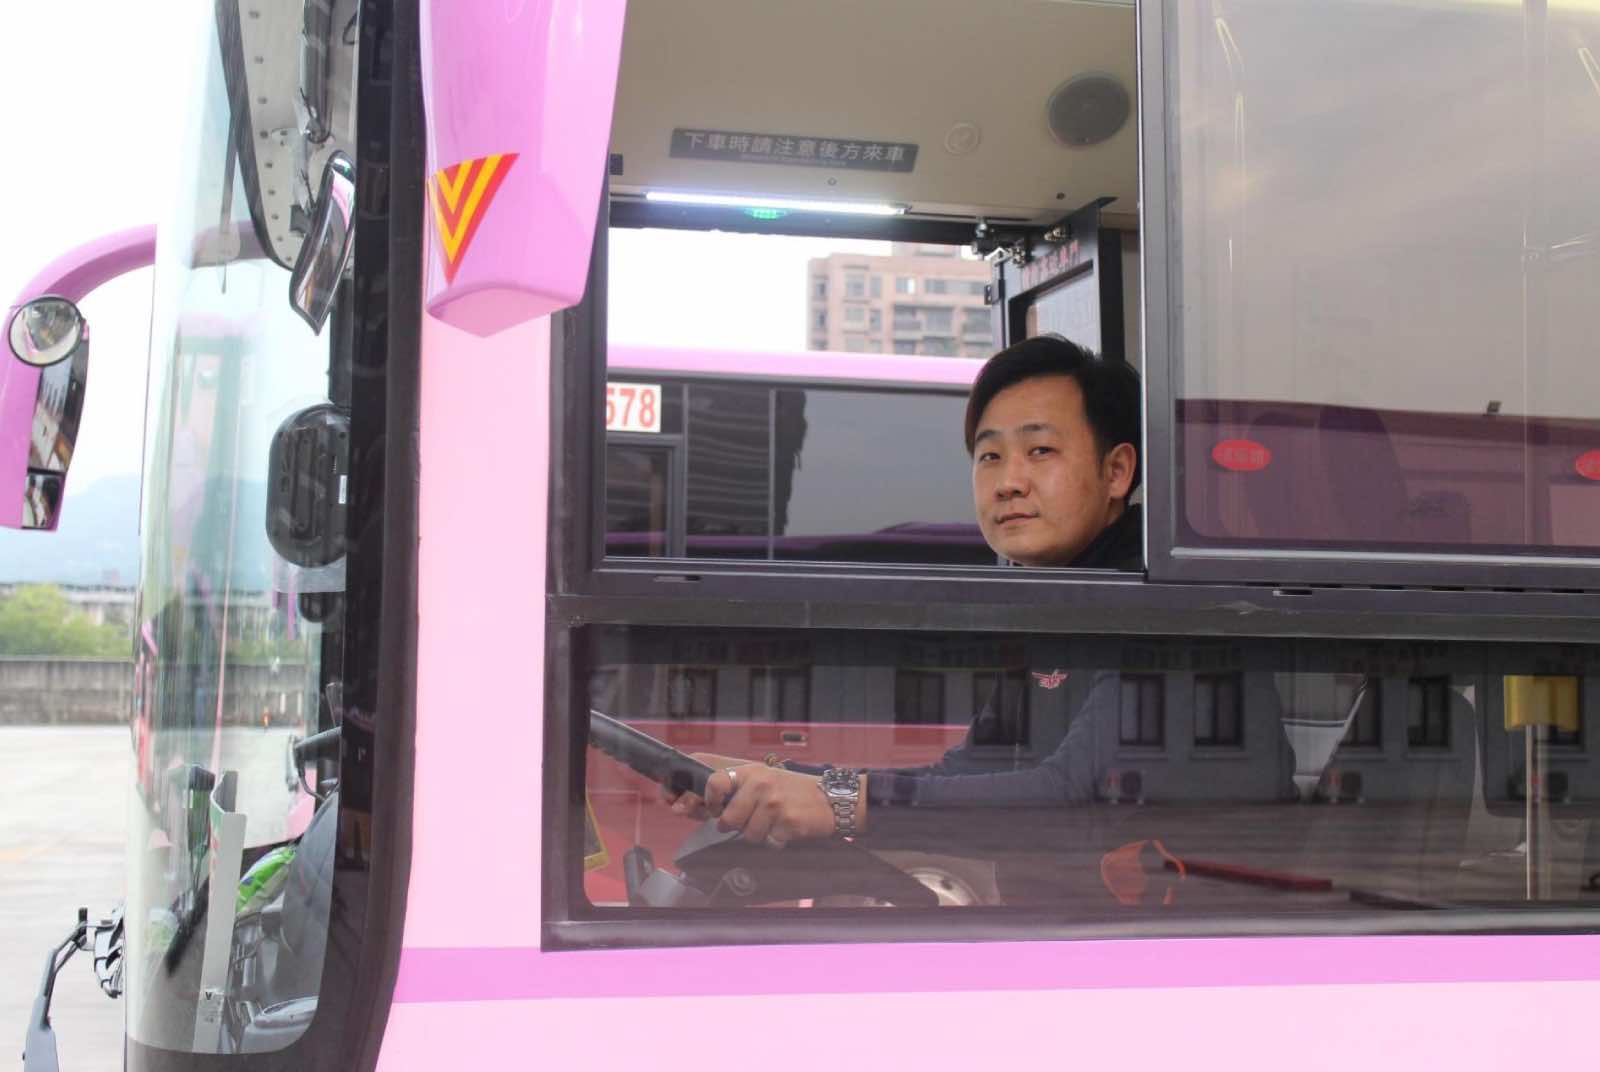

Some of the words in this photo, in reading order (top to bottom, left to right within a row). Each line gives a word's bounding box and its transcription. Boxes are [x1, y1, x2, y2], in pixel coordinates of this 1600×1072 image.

[685, 131, 905, 165] 下車時請注意後方來車
